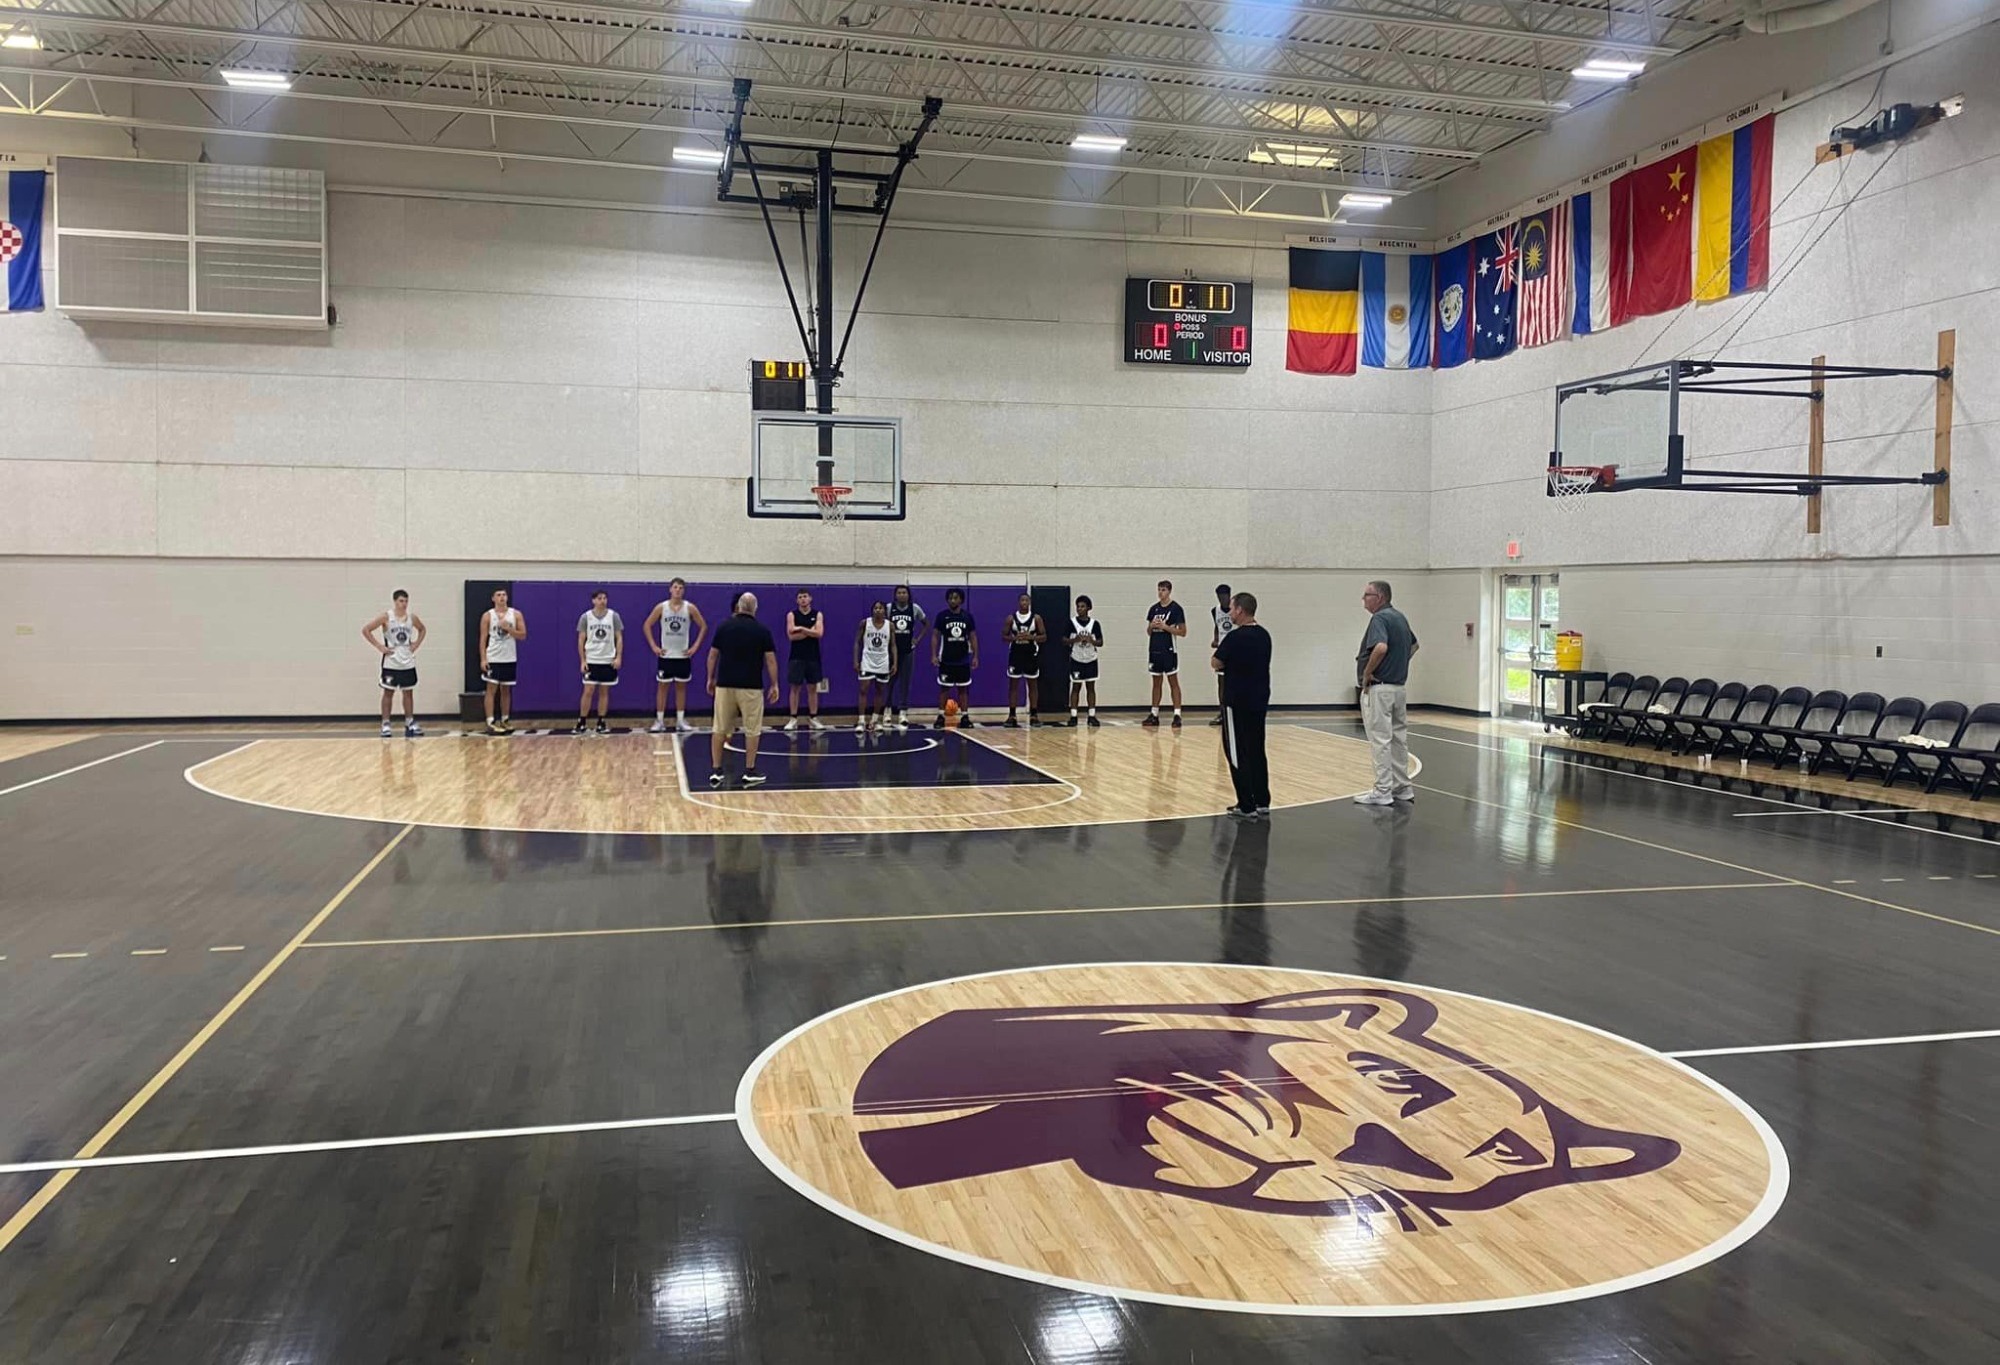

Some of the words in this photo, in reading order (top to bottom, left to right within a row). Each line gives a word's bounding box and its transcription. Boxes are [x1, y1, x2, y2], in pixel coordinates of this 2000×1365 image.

[1725, 102, 1760, 123] COLOMBIA
[1660, 138, 1680, 151] CHINA
[1581, 177, 1590, 186] THE
[1592, 159, 1628, 180] NETHERLANDS
[1379, 240, 1417, 249] ARGENTINA
[1174, 313, 1208, 323] BONUS
[1154, 323, 1168, 348] 0
[1175, 331, 1205, 340] PERIOD
[1232, 326, 1246, 350] 0
[1134, 349, 1172, 361] HOME
[1203, 351, 1251, 364] VISITOR
